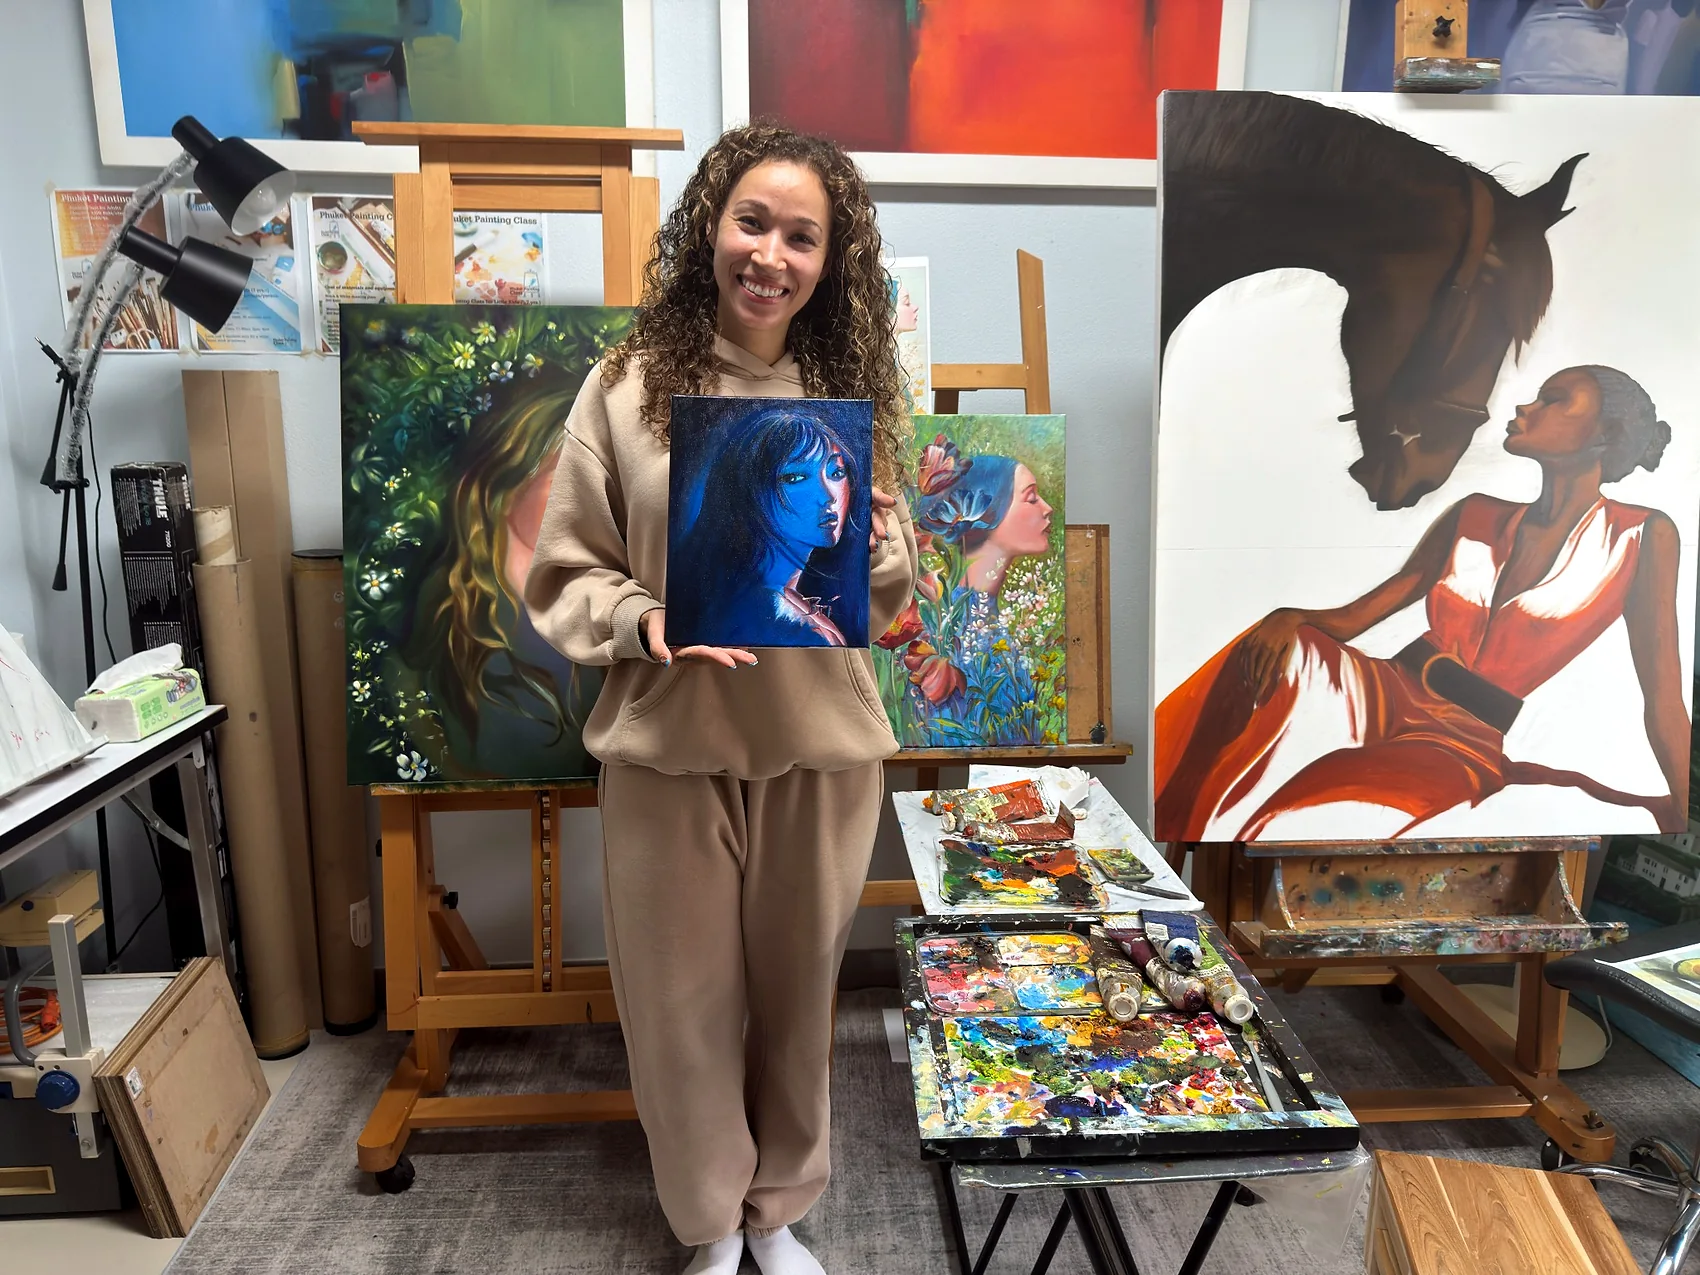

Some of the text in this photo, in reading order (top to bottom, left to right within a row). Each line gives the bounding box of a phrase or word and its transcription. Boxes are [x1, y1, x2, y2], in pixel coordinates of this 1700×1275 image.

[61, 194, 91, 203] Phuket
[475, 216, 512, 225] Painting
[513, 217, 538, 225] Class
[150, 478, 168, 519] THULE
